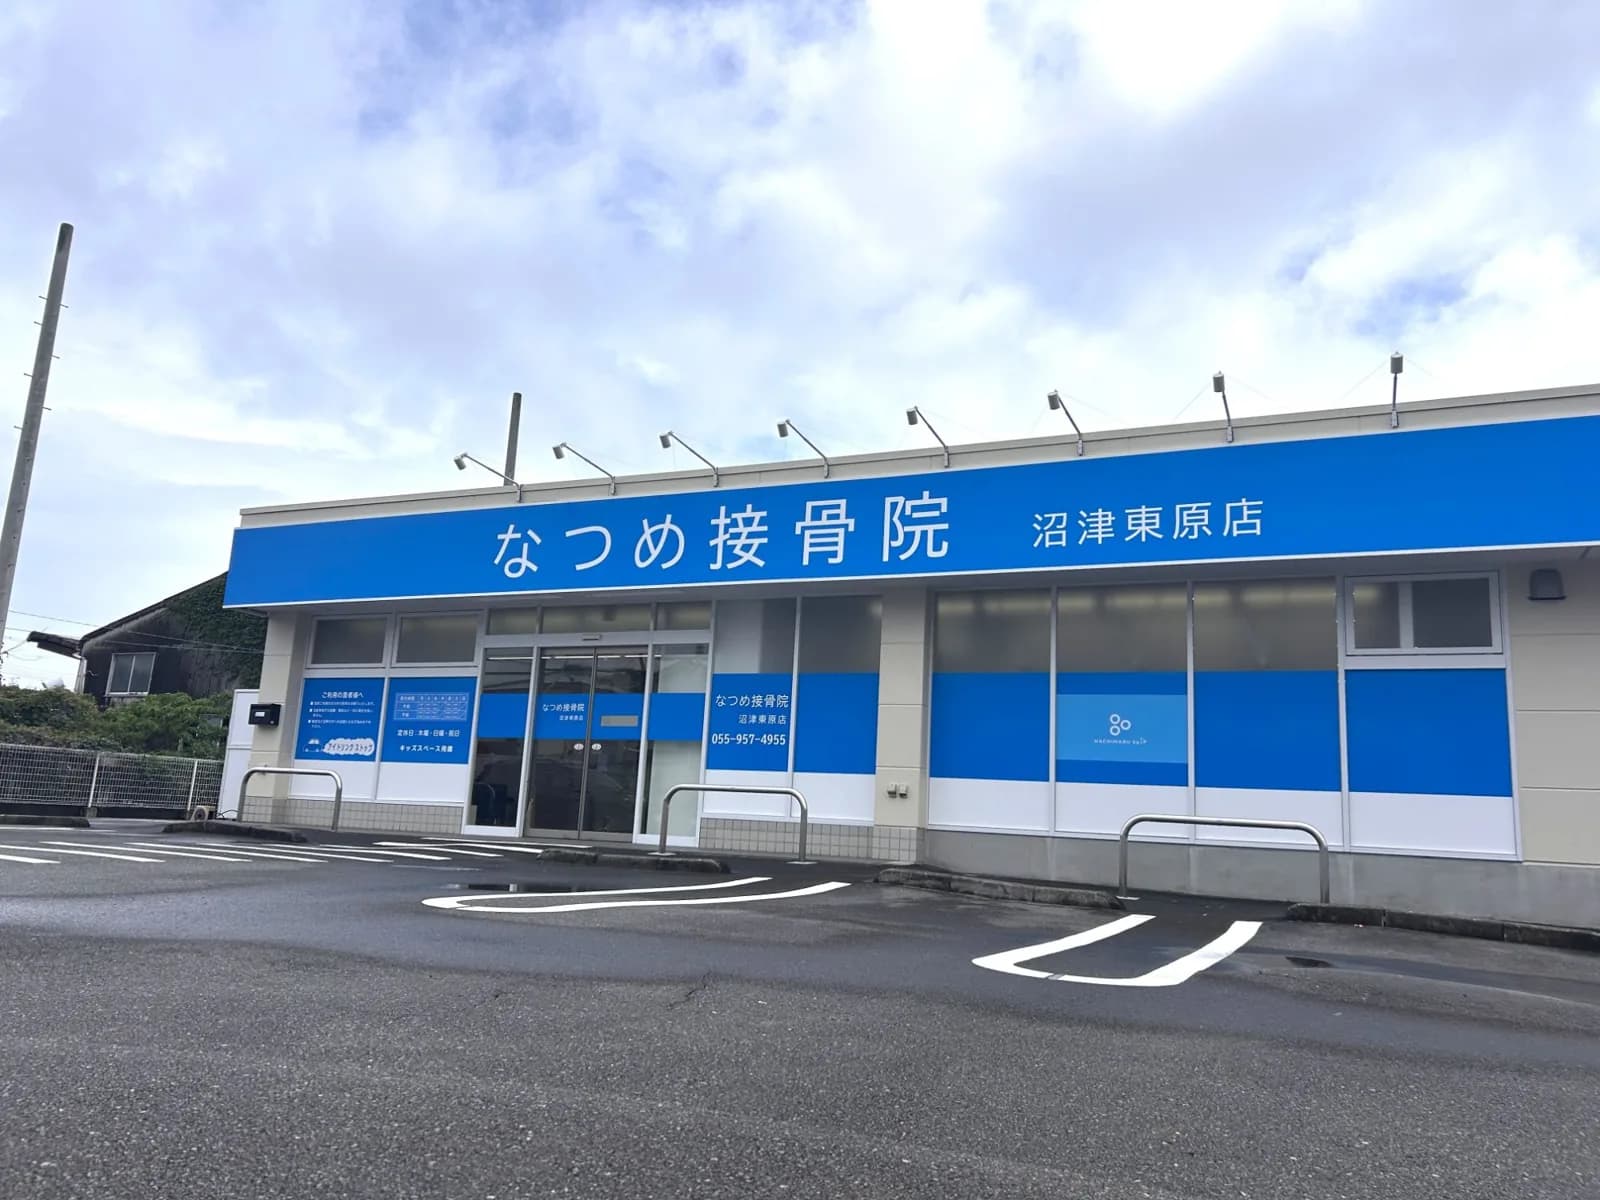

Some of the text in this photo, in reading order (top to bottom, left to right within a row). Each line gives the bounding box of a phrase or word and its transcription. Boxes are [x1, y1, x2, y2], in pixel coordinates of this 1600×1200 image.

[493, 490, 1264, 579] なつめ接骨院 沼津東原店
[715, 693, 790, 708] なつめ接骨院
[542, 703, 585, 712] なつめ接骨院
[738, 714, 787, 725] 沼津東原店
[711, 732, 787, 746] 055-957-4955
[400, 744, 454, 753] キッズスペース
